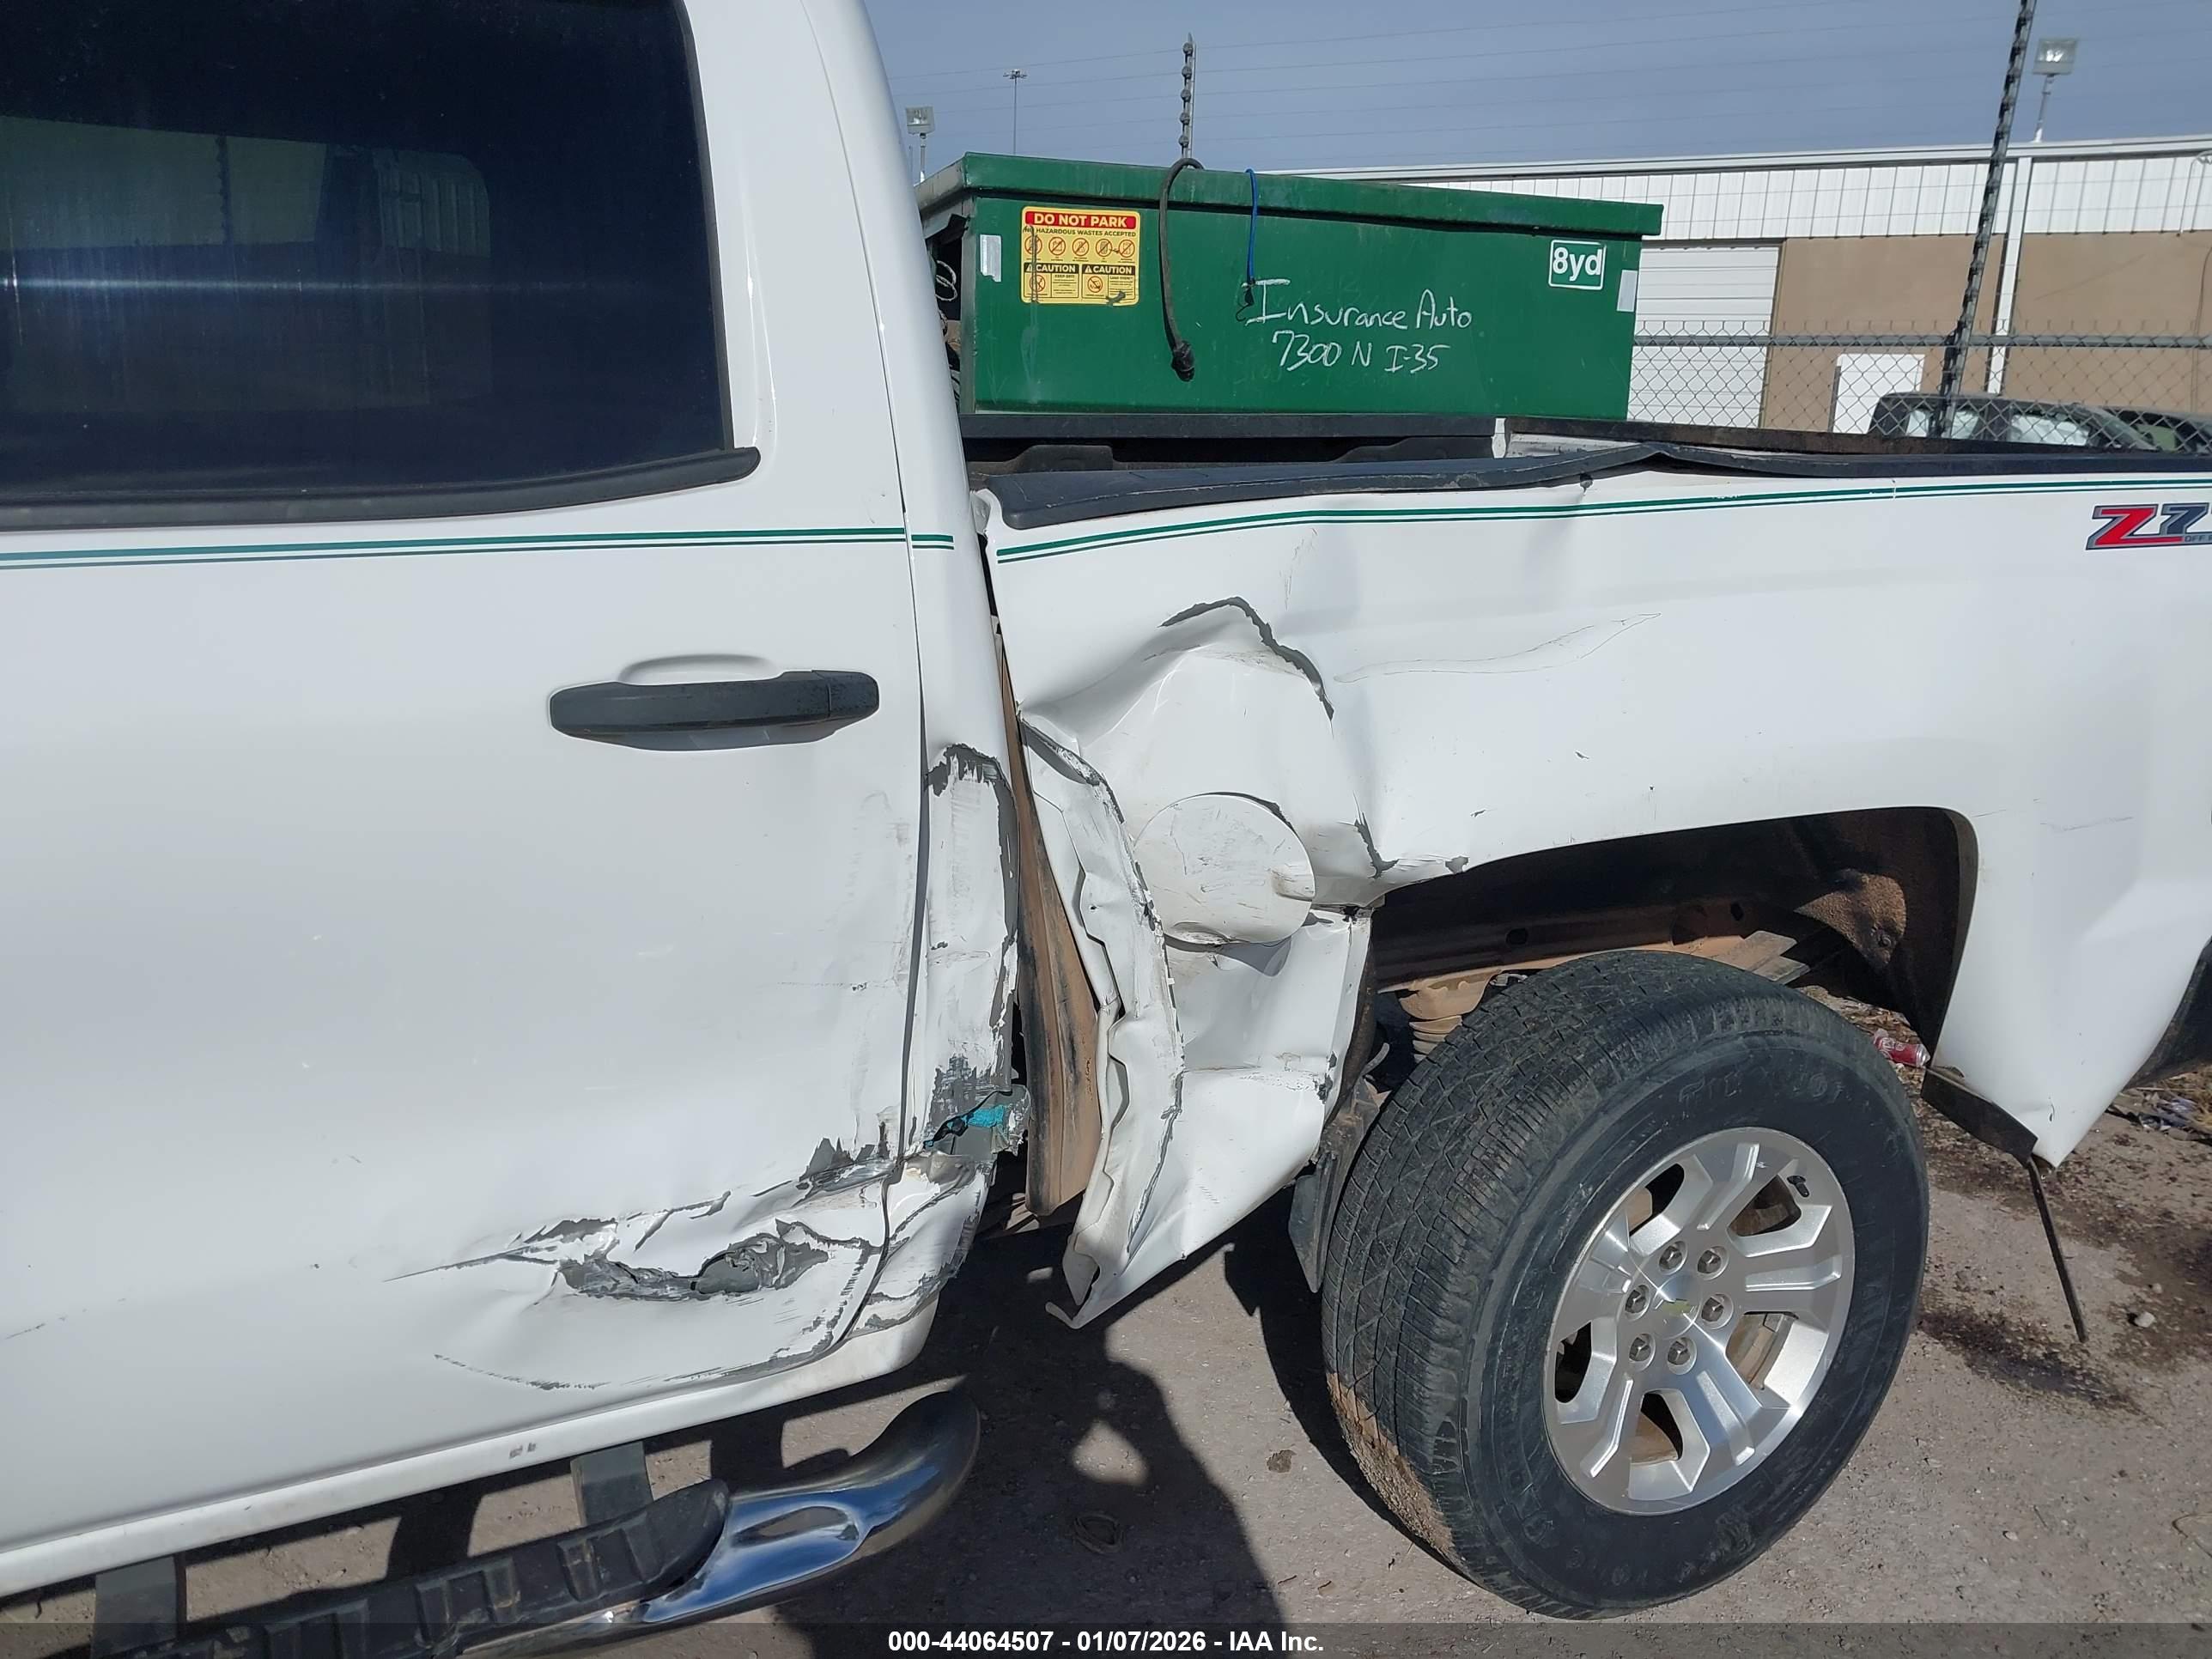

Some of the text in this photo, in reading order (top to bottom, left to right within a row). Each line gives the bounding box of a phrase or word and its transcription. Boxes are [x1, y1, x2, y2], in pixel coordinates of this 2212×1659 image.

[1034, 213, 1127, 228] DO NOT PARK
[1036, 264, 1075, 273] CAUTION
[1093, 265, 1132, 274] CAUTION
[1553, 246, 1603, 282] 8yd
[1242, 278, 1472, 331] Insurance Auto
[1272, 330, 1451, 374] 7300 N I-35
